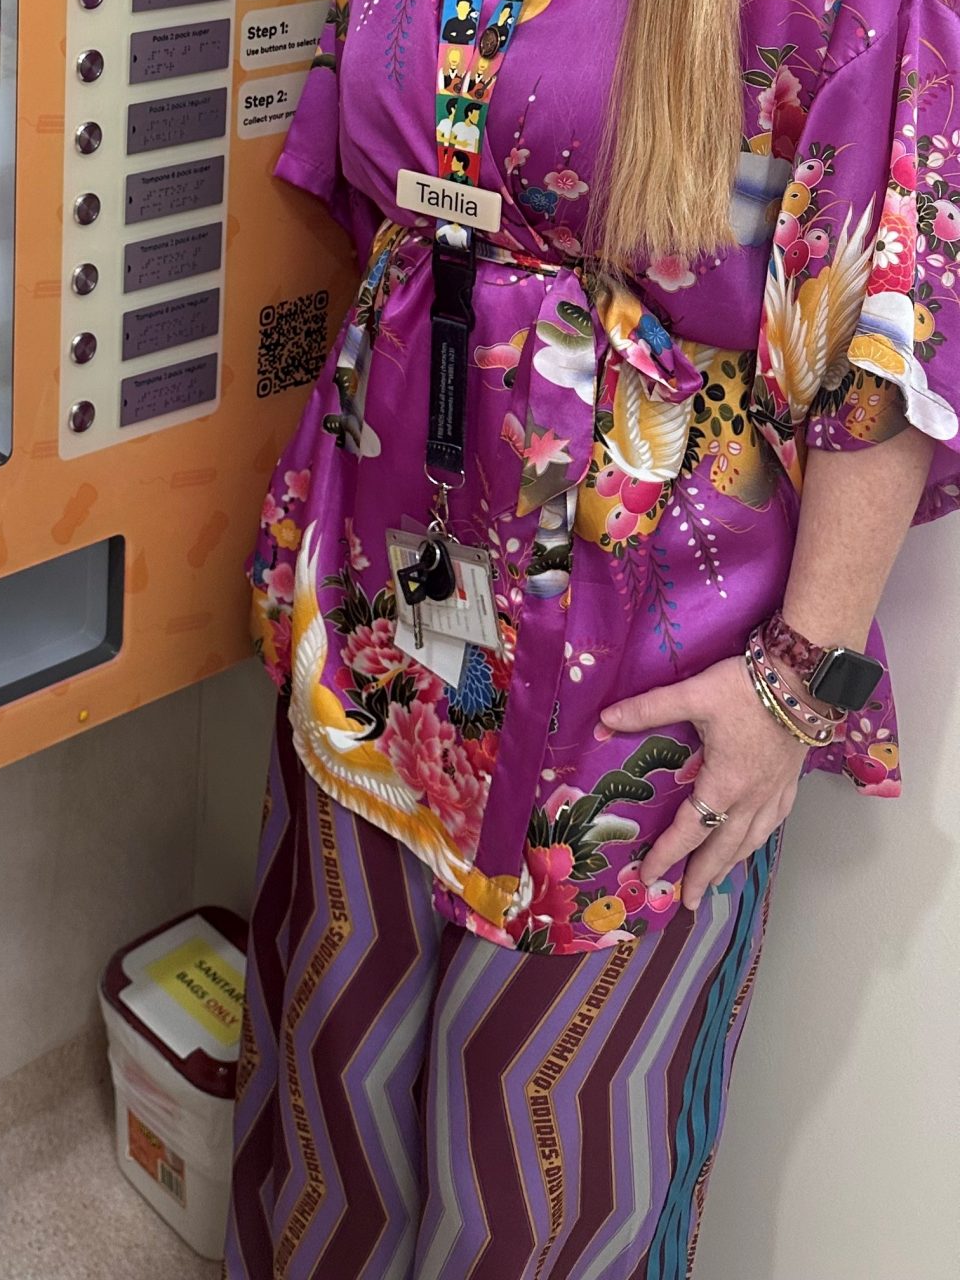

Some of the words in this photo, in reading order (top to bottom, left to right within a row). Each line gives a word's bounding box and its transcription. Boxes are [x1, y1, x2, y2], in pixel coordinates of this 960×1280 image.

[246, 48, 260, 57] Use
[260, 44, 287, 55] buttons
[296, 38, 316, 48] select
[247, 25, 278, 40] Step
[279, 22, 289, 35] 1:
[243, 114, 268, 126] Collect
[268, 111, 284, 123] your
[244, 94, 274, 110] Step
[276, 90, 288, 104] 2:
[416, 182, 478, 217] Tahlia
[324, 855, 348, 923] ADIDAS
[193, 958, 245, 1007] SANITAR
[585, 942, 634, 1010] ADIDAS
[175, 970, 207, 1002] BAGS
[205, 997, 238, 1026] ONLY
[551, 1011, 594, 1062] FARM
[532, 1059, 564, 1091] RIO
[530, 1094, 559, 1161] ADIDAS
